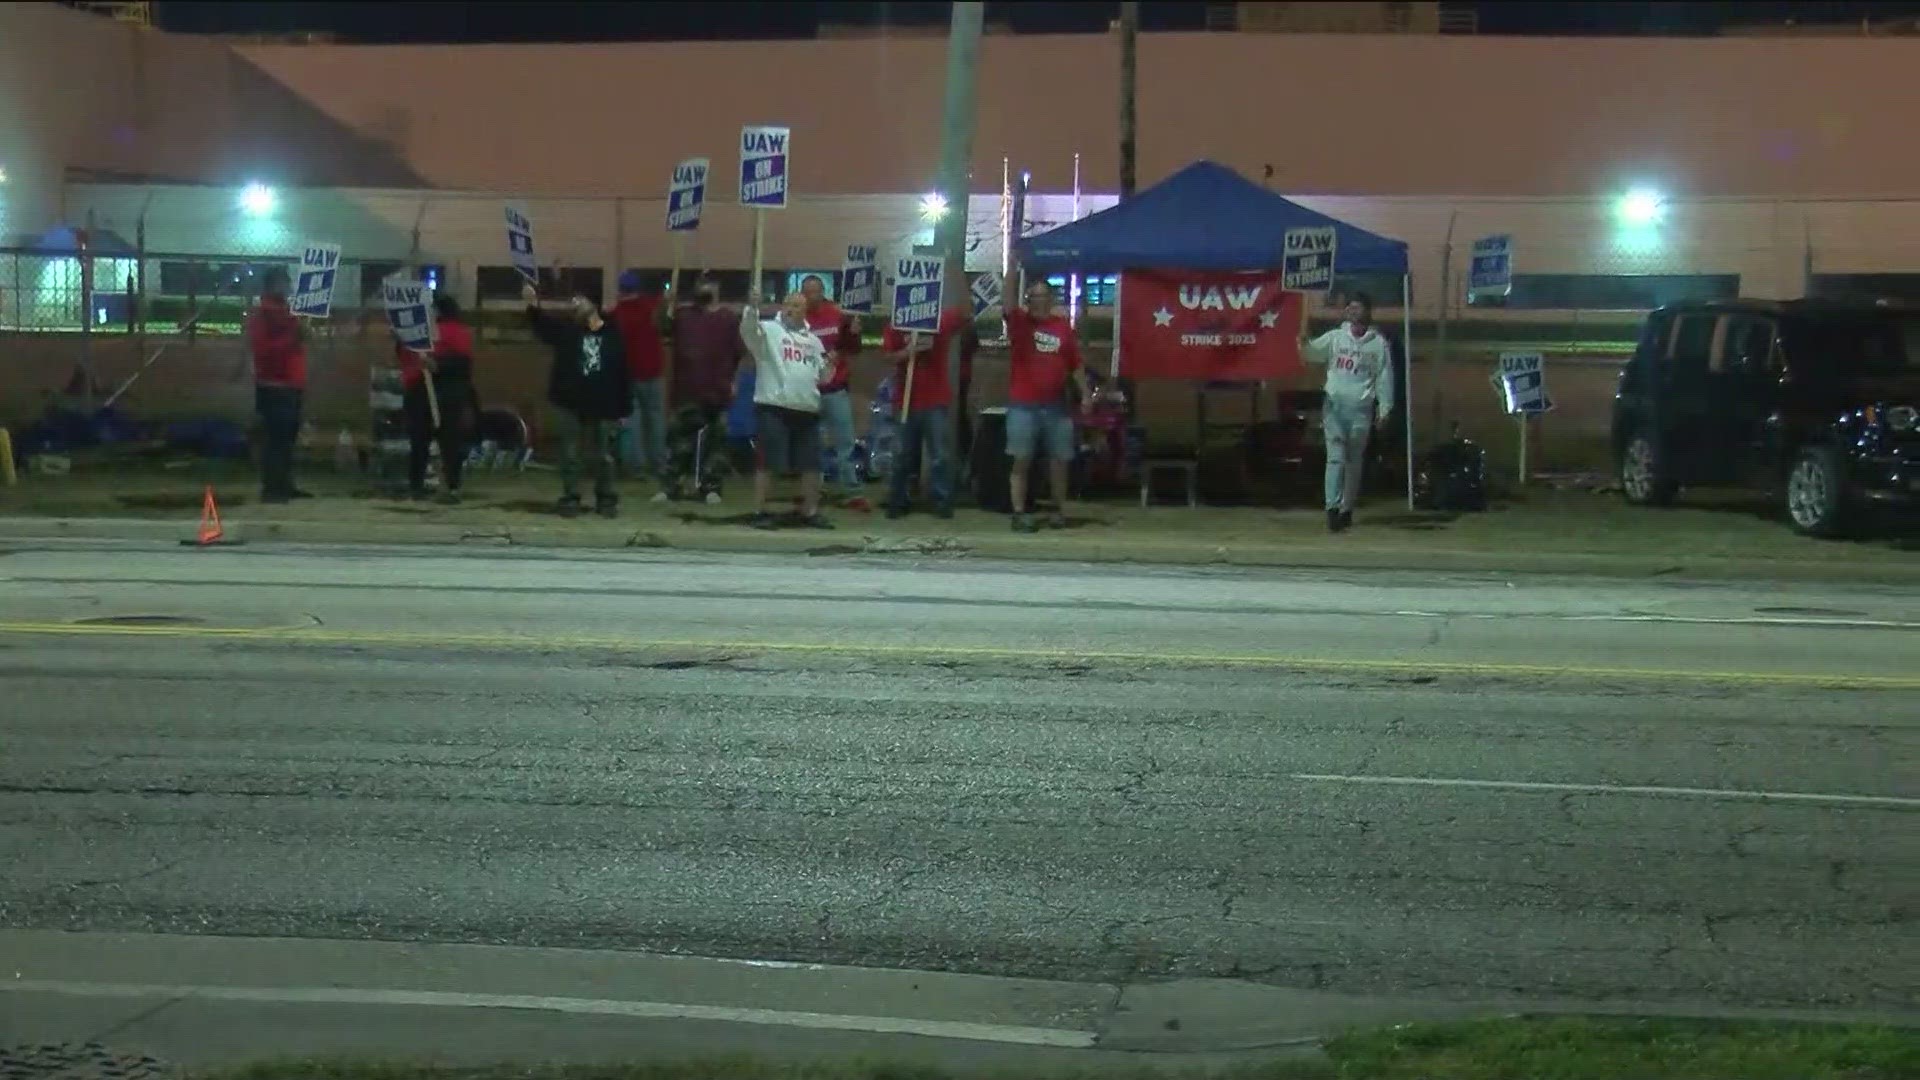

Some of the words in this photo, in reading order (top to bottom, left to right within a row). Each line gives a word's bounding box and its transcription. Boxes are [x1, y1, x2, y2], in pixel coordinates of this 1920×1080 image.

[744, 132, 785, 152] UAW
[673, 165, 706, 183] UAW
[755, 160, 772, 180] ON
[742, 178, 785, 201] STRIKE
[1287, 233, 1332, 250] UAW
[304, 247, 338, 268] UAW
[848, 244, 877, 262] UAW
[898, 259, 941, 279] UAW
[385, 285, 421, 304] UAW
[909, 286, 927, 303] ON
[1179, 285, 1262, 311] UAW
[895, 301, 939, 324] STRIKE
[1181, 334, 1222, 346] STRIKE
[1503, 357, 1539, 371] UAW
